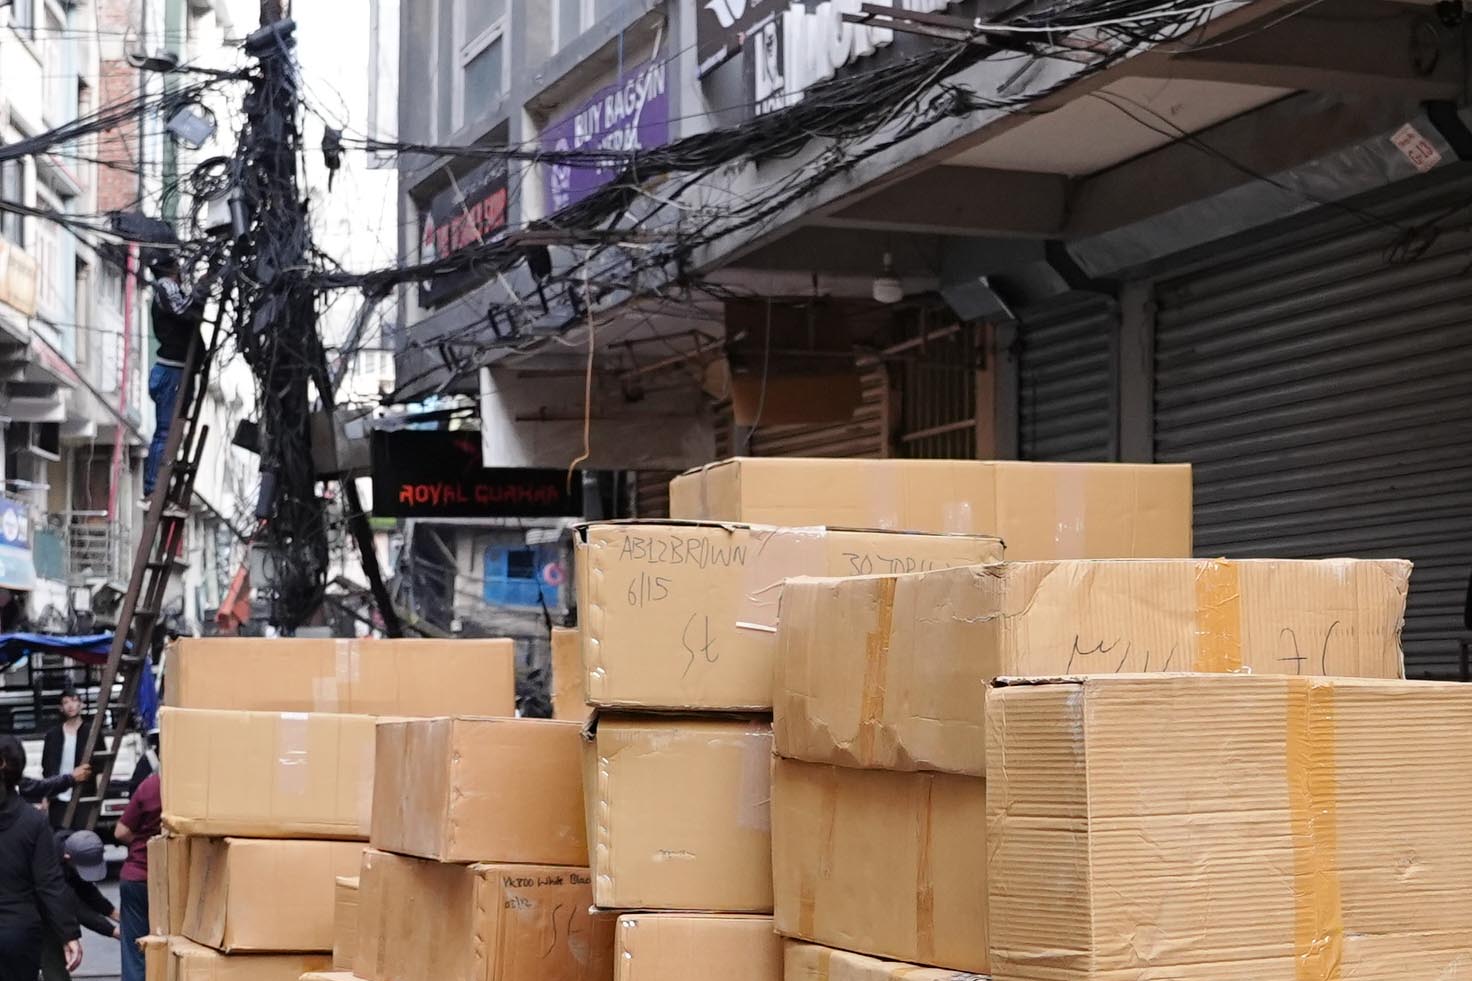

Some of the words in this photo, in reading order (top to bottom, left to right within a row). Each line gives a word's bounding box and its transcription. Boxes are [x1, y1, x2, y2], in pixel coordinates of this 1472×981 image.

[574, 101, 603, 149] BUY
[605, 71, 646, 129] BAGS
[399, 483, 469, 507] ROYAL
